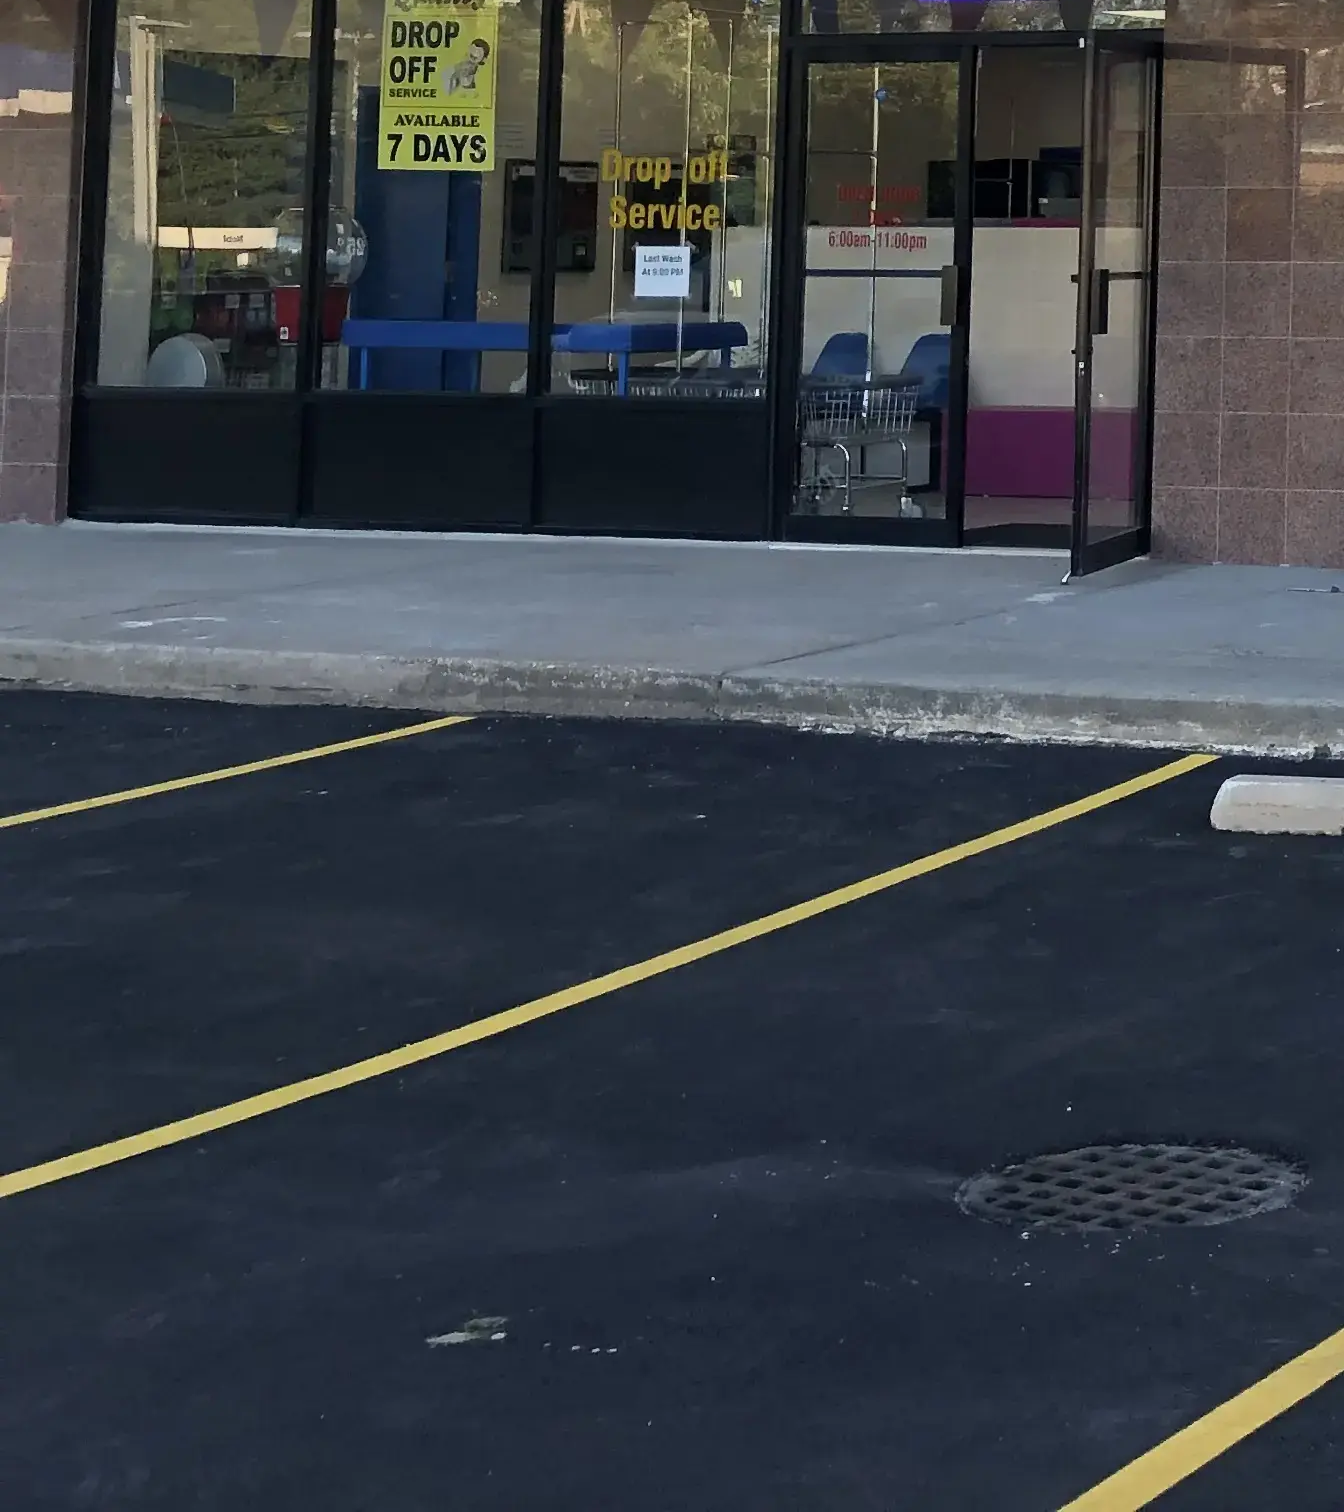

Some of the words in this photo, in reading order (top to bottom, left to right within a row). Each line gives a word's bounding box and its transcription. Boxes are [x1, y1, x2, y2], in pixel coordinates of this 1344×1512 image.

[391, 20, 460, 49] DROP
[389, 56, 437, 84] OFF
[389, 88, 437, 98] SERVICE
[394, 114, 480, 128] AVAILABLE
[387, 134, 403, 162] 7
[413, 134, 487, 163] DAYS
[601, 148, 672, 190] Drop
[689, 149, 729, 184] off
[609, 195, 720, 231] Service
